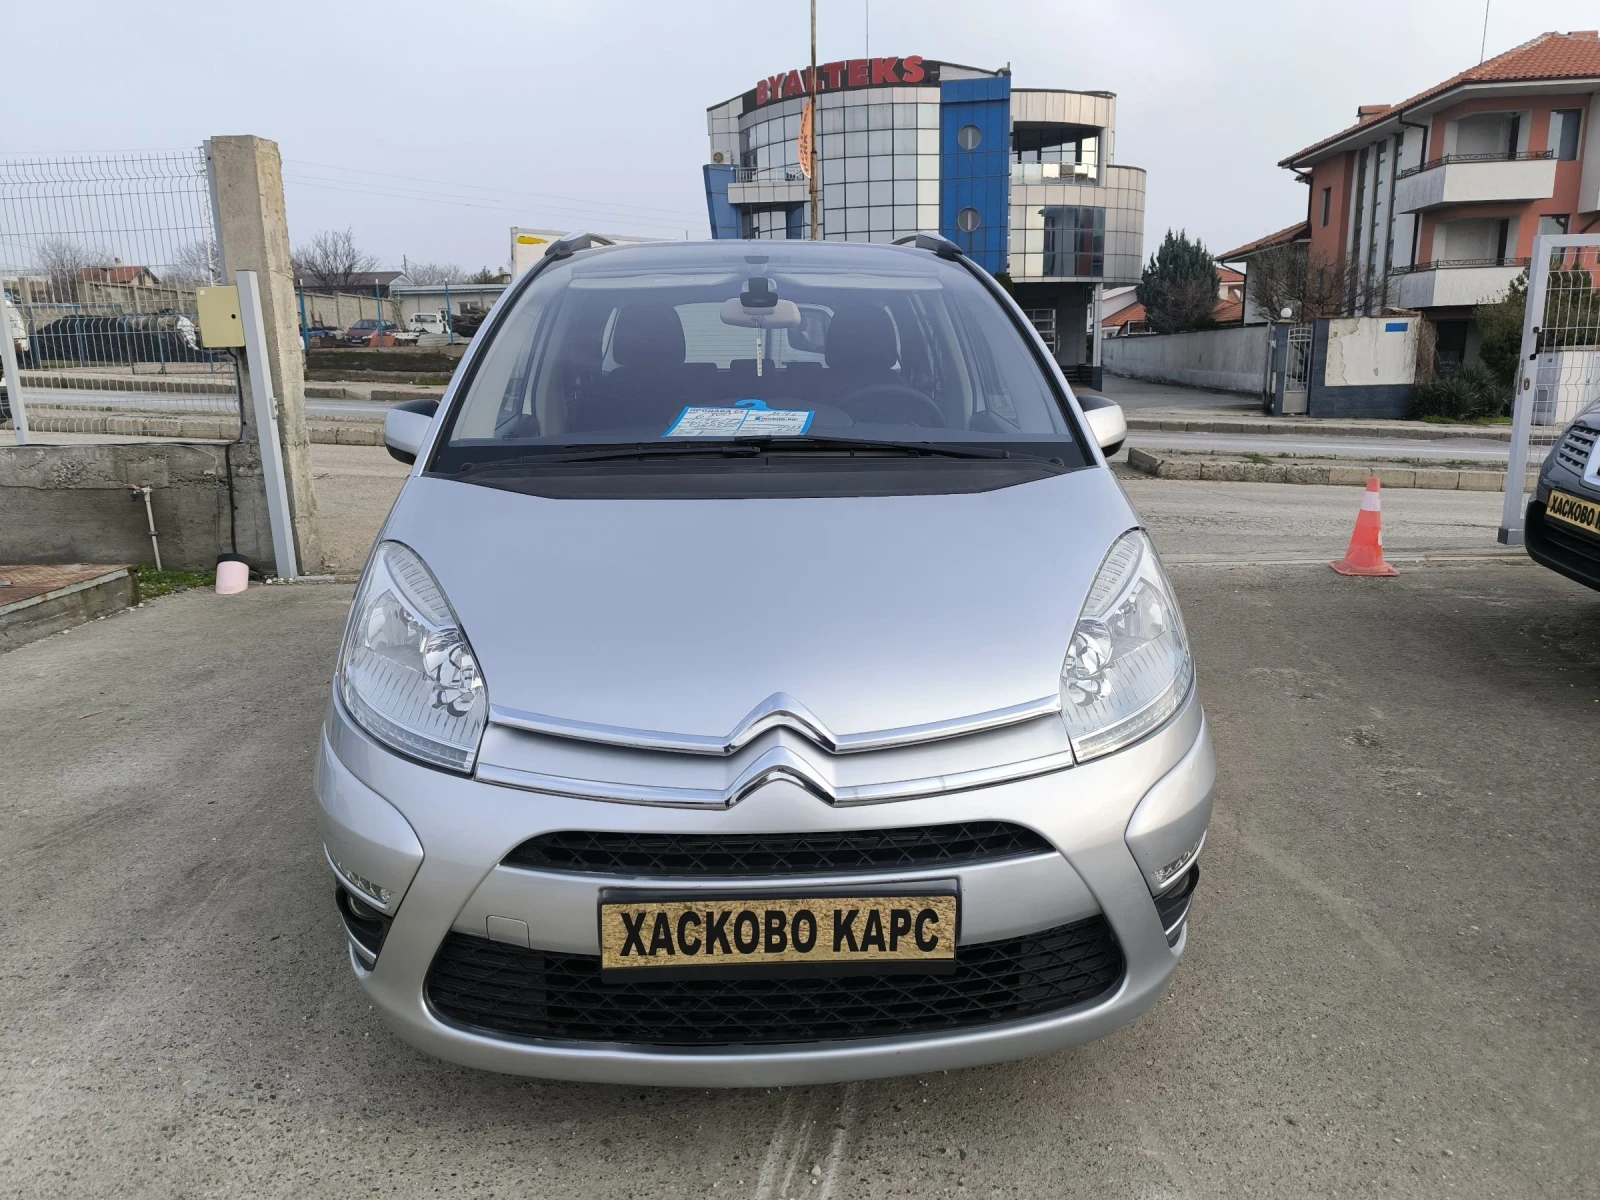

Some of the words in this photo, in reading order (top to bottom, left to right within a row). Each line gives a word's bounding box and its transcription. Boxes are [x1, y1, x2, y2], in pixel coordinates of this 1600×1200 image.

[756, 55, 925, 106] BYALTEKS
[1550, 495, 1595, 527] ХАСКОВО
[619, 909, 818, 957] ХАСКОВО
[833, 908, 940, 953] КАРС
